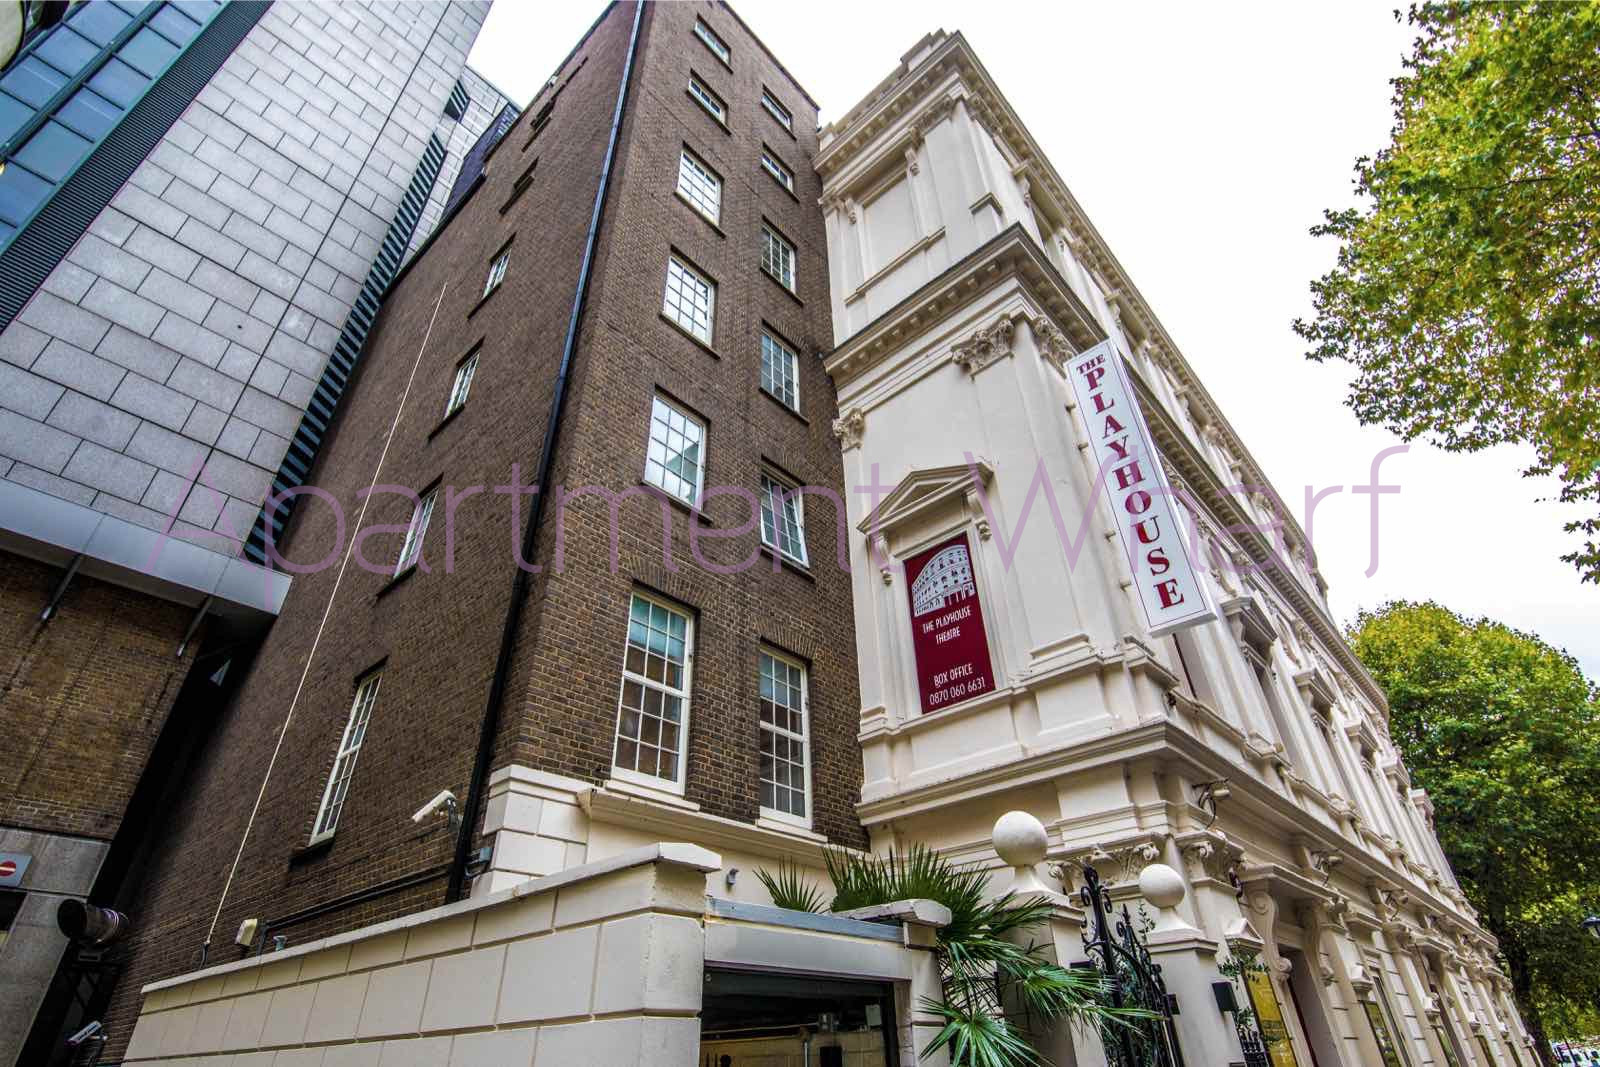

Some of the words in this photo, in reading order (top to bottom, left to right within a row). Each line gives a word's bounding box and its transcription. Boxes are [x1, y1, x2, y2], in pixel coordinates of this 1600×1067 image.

[1075, 354, 1106, 375] THE
[1083, 367, 1185, 610] PLAYHOUSE
[922, 619, 935, 634] THE
[936, 605, 971, 628] PLAYHOUSE
[936, 626, 961, 645] THEATRE
[934, 671, 949, 687] BOX
[950, 663, 974, 681] OFFICE
[930, 690, 949, 705] 0870
[950, 684, 967, 698] 060
[967, 676, 986, 693] 6631
